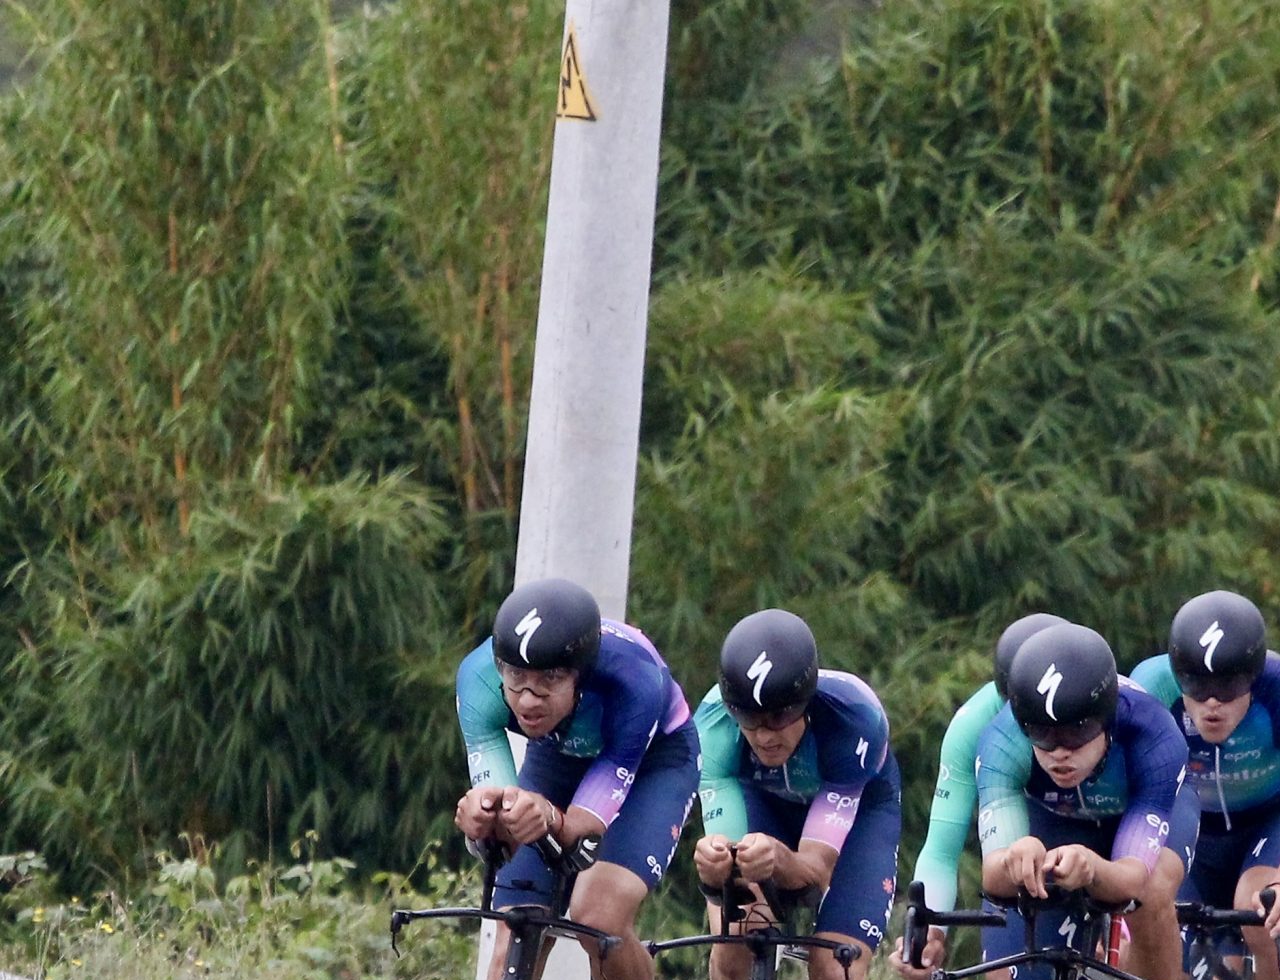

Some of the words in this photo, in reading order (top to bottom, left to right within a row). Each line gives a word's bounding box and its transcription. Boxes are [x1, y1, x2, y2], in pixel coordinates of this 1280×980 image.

[472, 769, 491, 786] CER
[616, 766, 636, 788] ep
[703, 807, 724, 822] CER
[980, 825, 998, 843] CER
[1146, 813, 1170, 837] ep
[646, 855, 663, 881] ep
